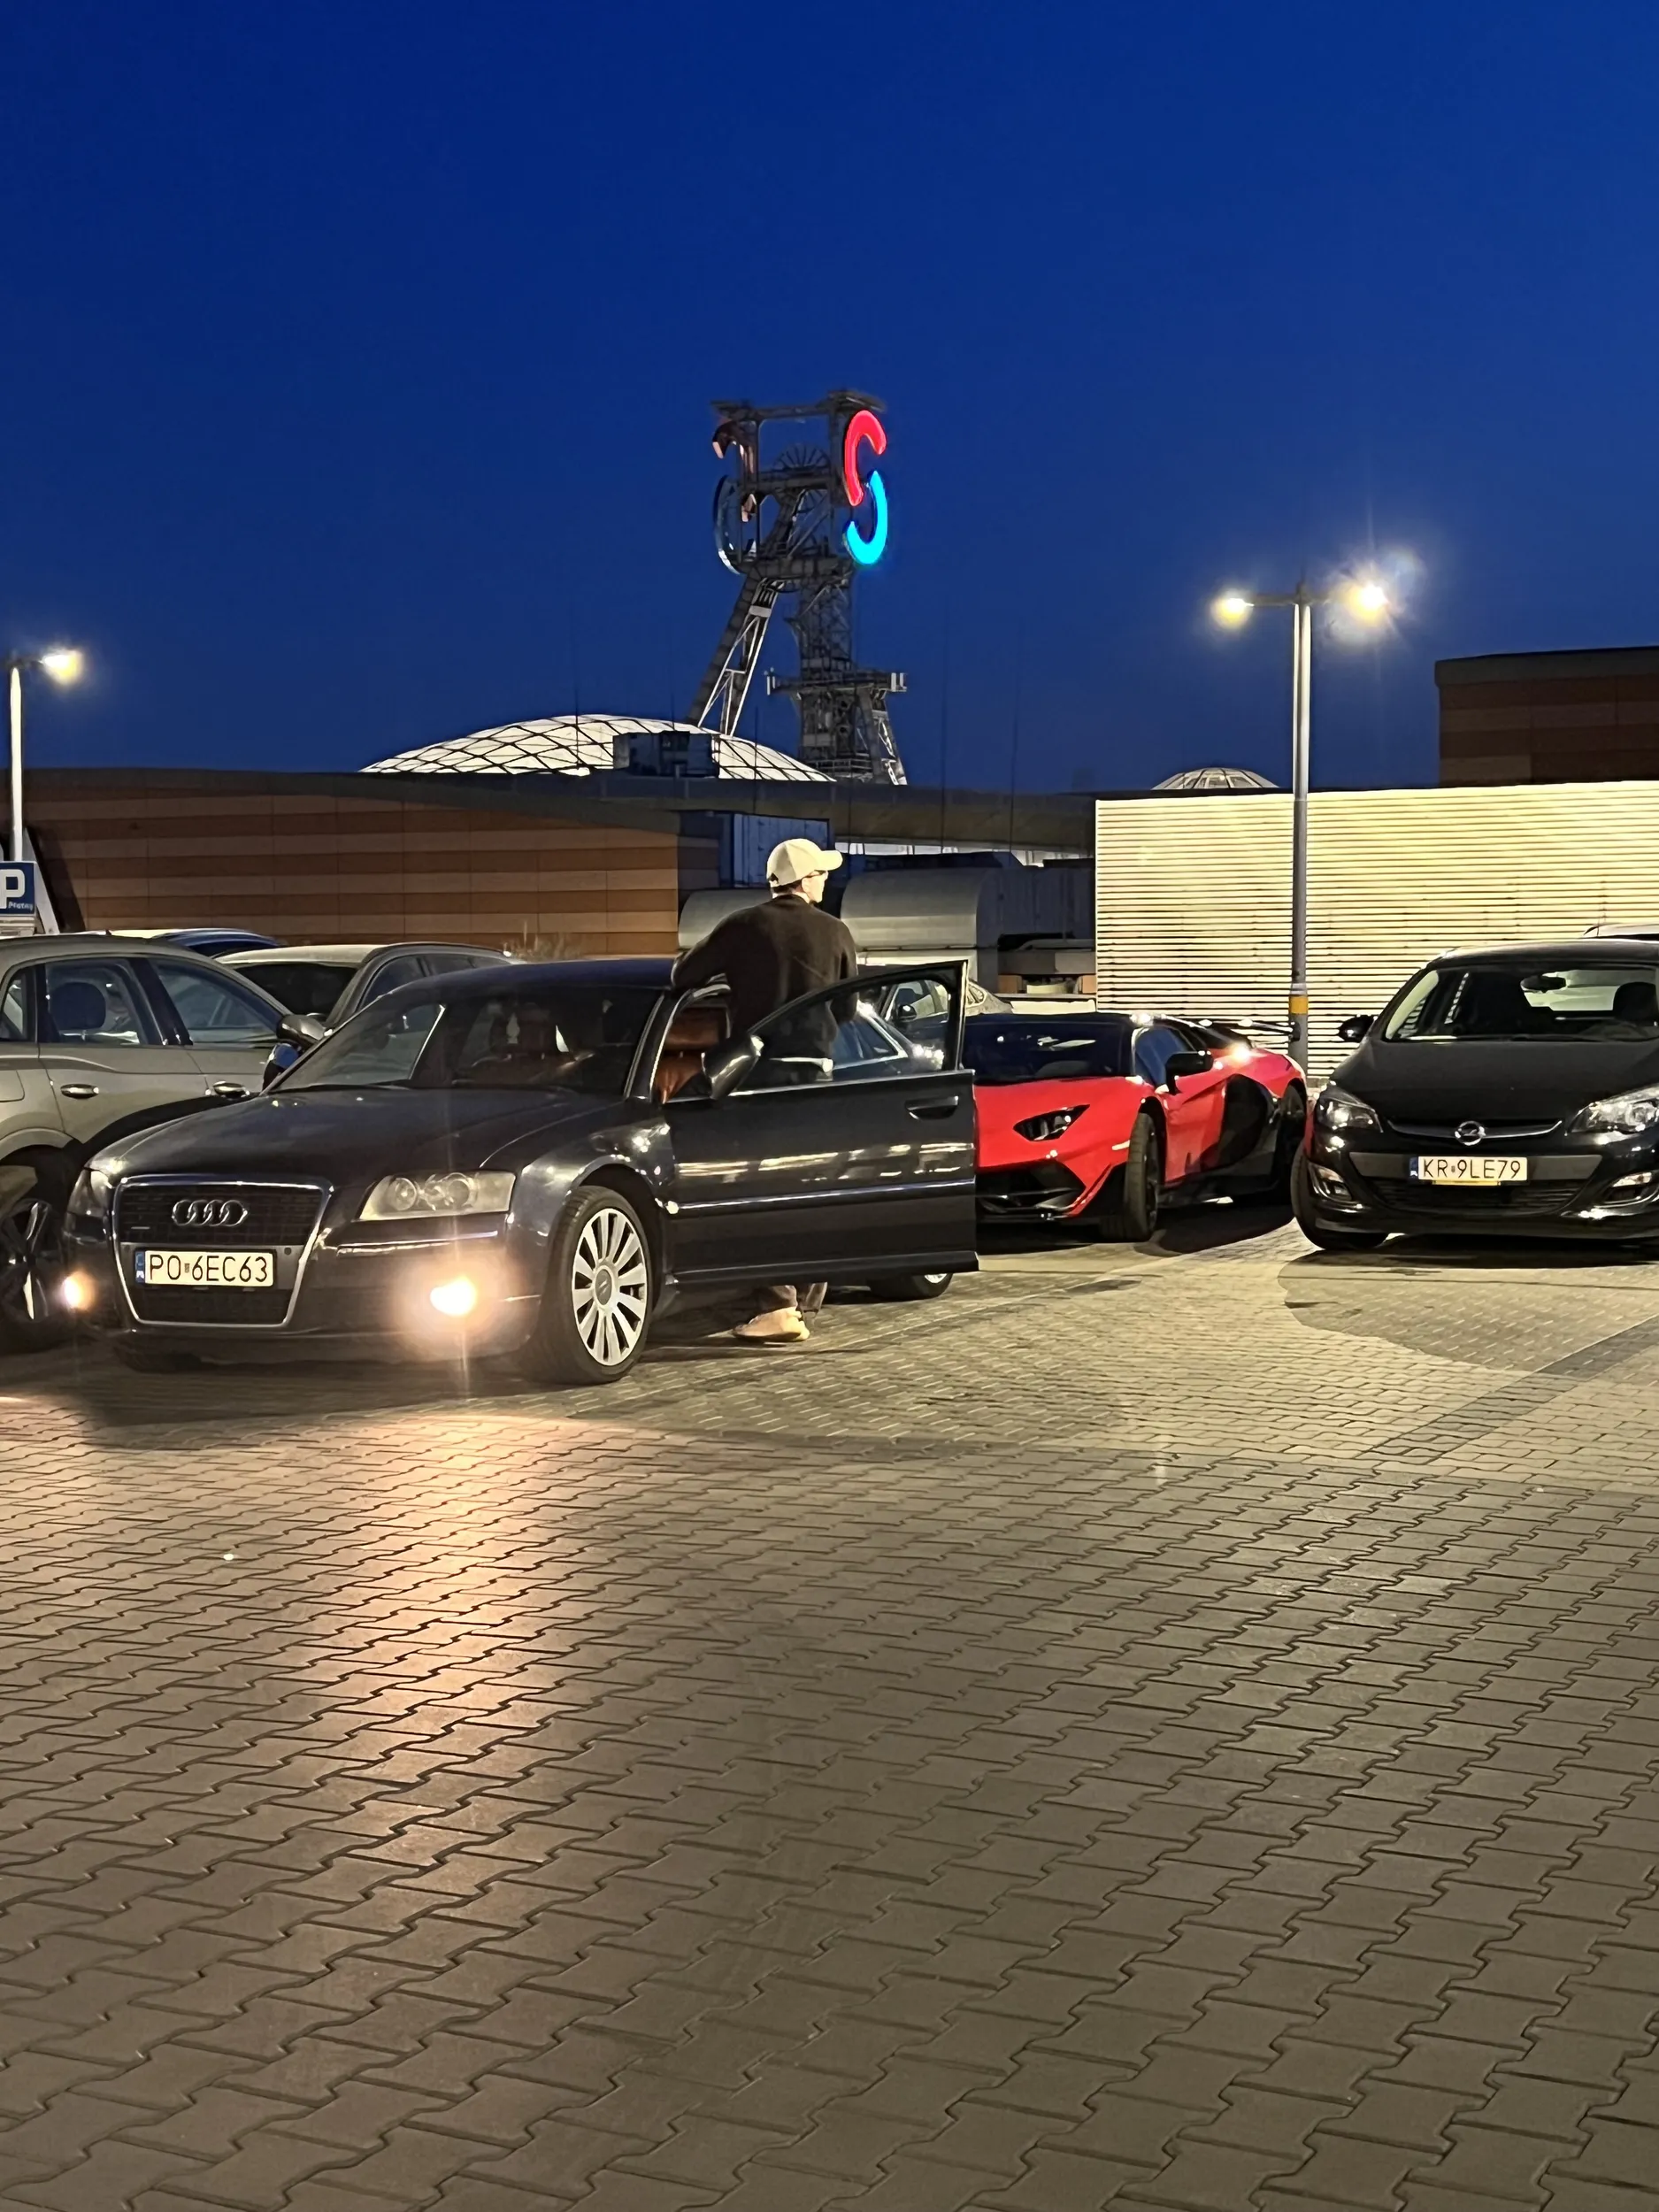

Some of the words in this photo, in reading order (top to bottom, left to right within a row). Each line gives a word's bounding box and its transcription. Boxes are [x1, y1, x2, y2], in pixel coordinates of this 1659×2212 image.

[0, 869, 25, 909] P
[1424, 1159, 1448, 1178] KR
[1457, 1159, 1521, 1179] 9LE79
[150, 1254, 181, 1280] PO
[192, 1256, 267, 1282] 6EC63
